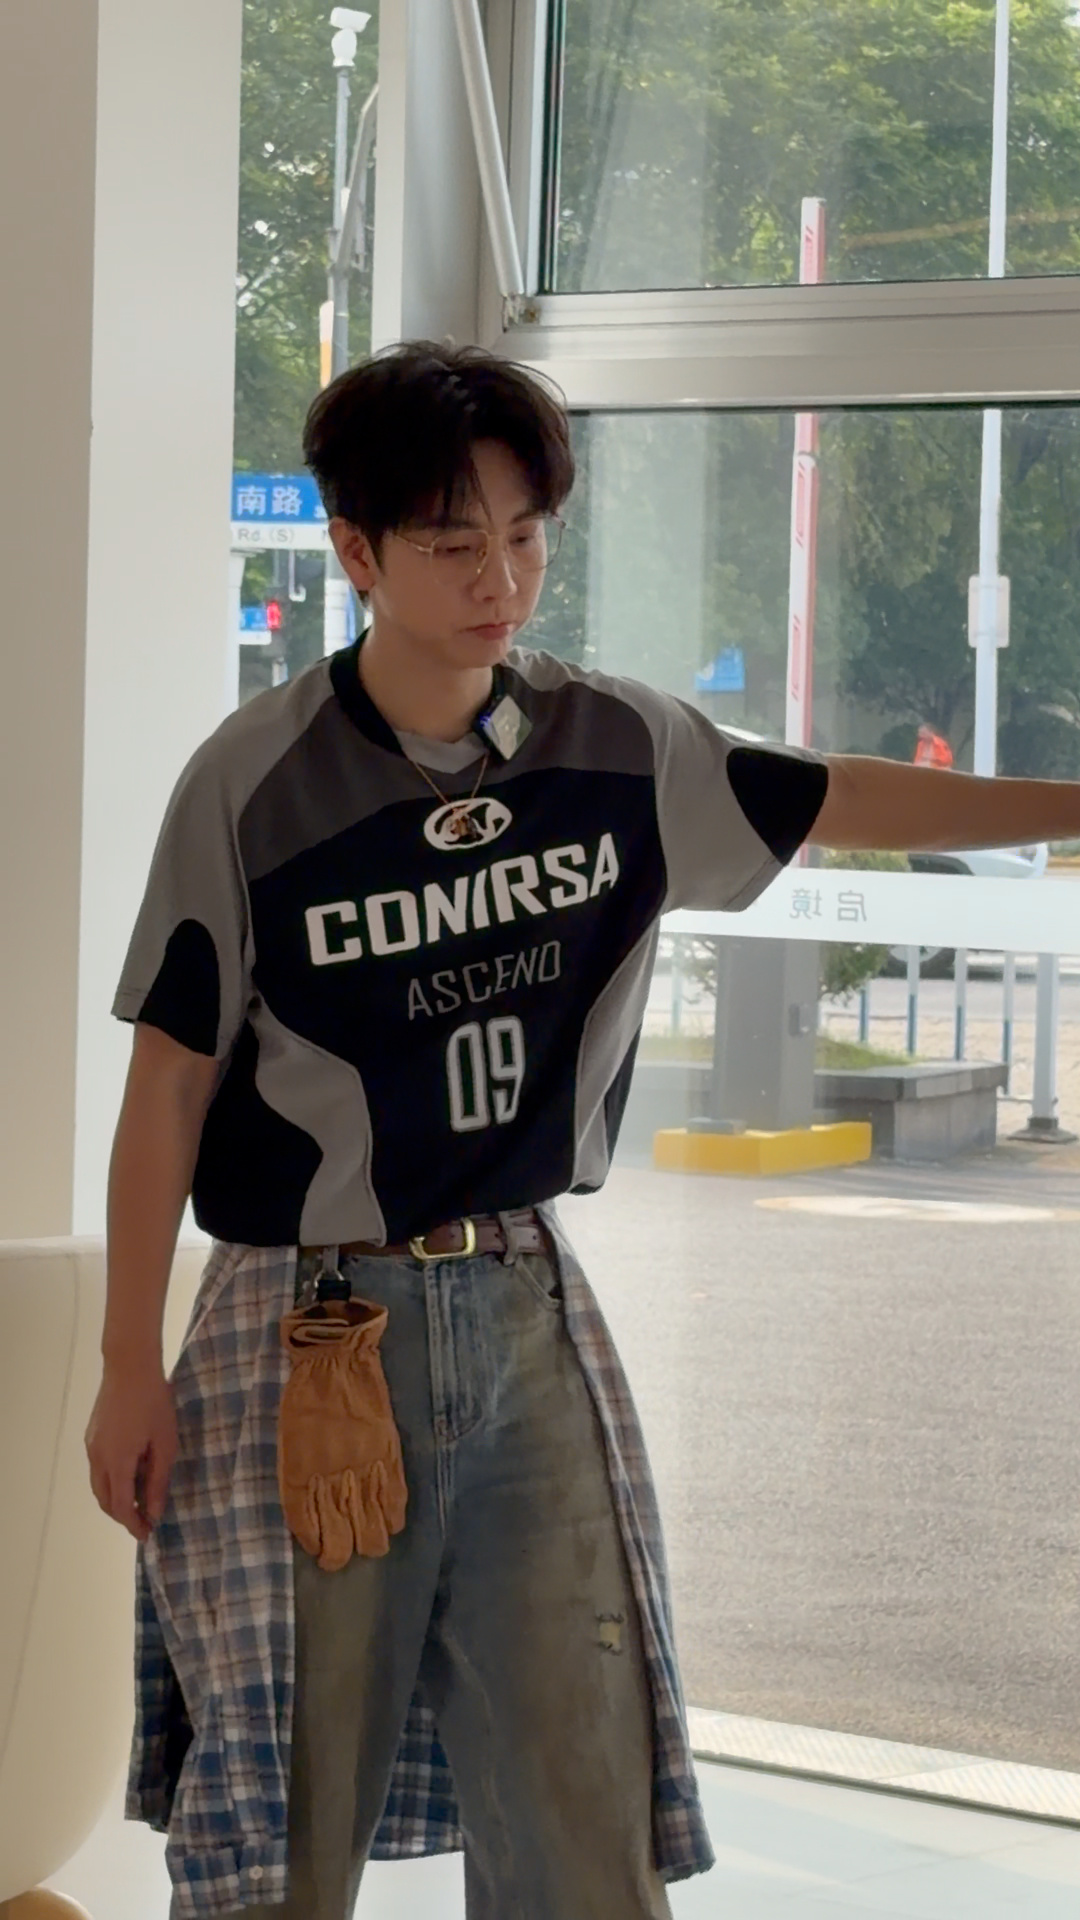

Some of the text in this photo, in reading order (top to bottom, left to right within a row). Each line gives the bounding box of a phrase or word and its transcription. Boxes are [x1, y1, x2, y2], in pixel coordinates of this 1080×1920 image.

[237, 485, 303, 516] 南路
[305, 833, 619, 966] CONIRSA
[408, 940, 561, 1020] ASCEND
[447, 1015, 526, 1132] 09
